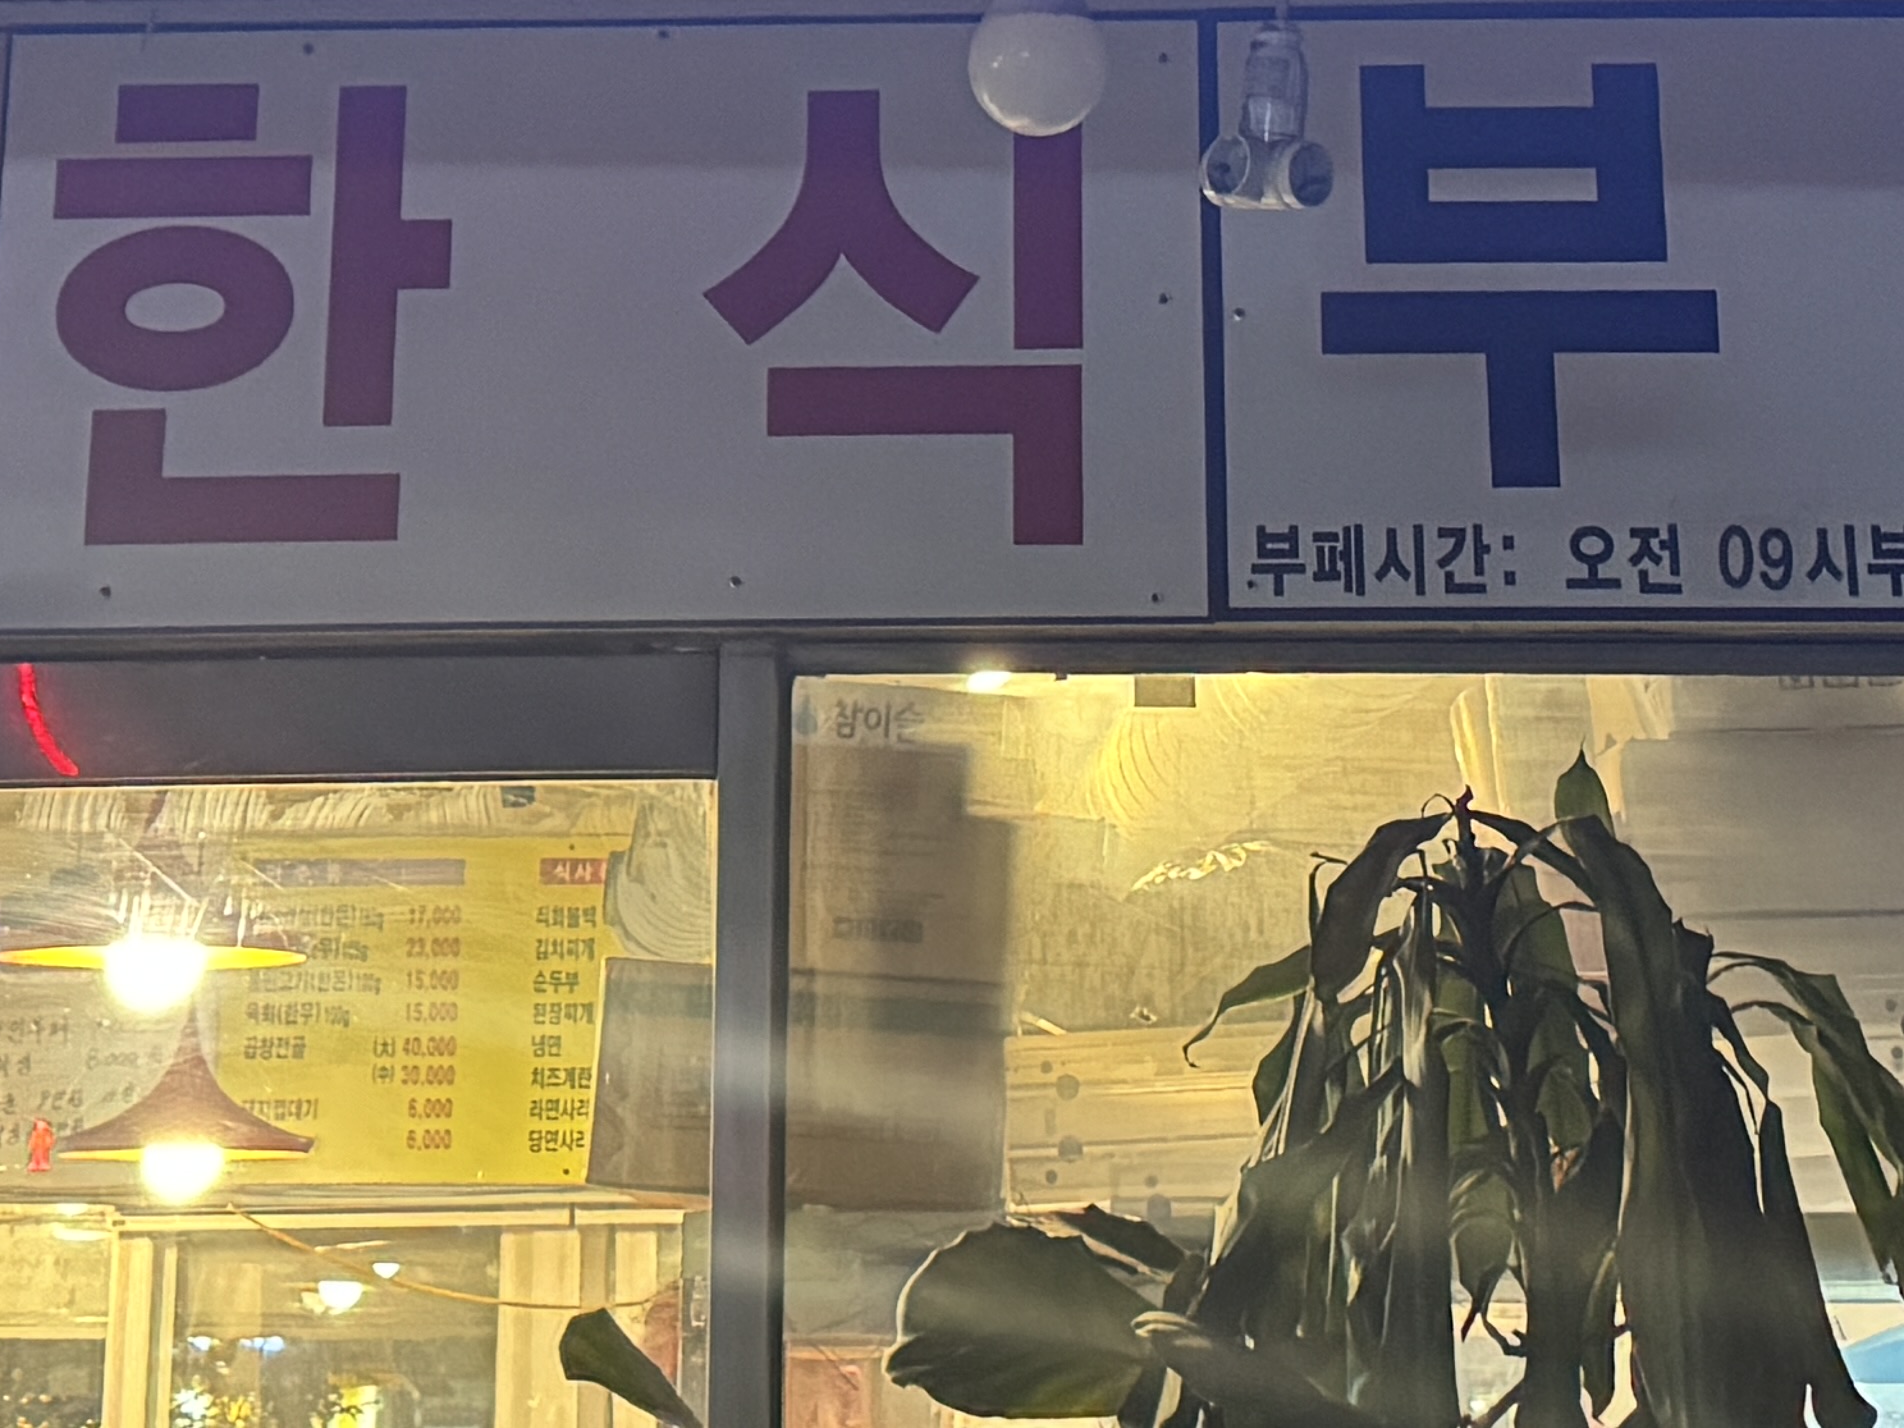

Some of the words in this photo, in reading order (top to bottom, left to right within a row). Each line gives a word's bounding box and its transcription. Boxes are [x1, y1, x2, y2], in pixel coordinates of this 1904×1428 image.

[1250, 522, 1518, 598] 부페시간:
[1564, 522, 1684, 594] 오전
[533, 969, 579, 994] 순두부
[406, 1002, 458, 1023] 15,000
[402, 1035, 457, 1058] 40,000
[532, 1035, 562, 1057] 냉면
[400, 1064, 456, 1086] 30,000
